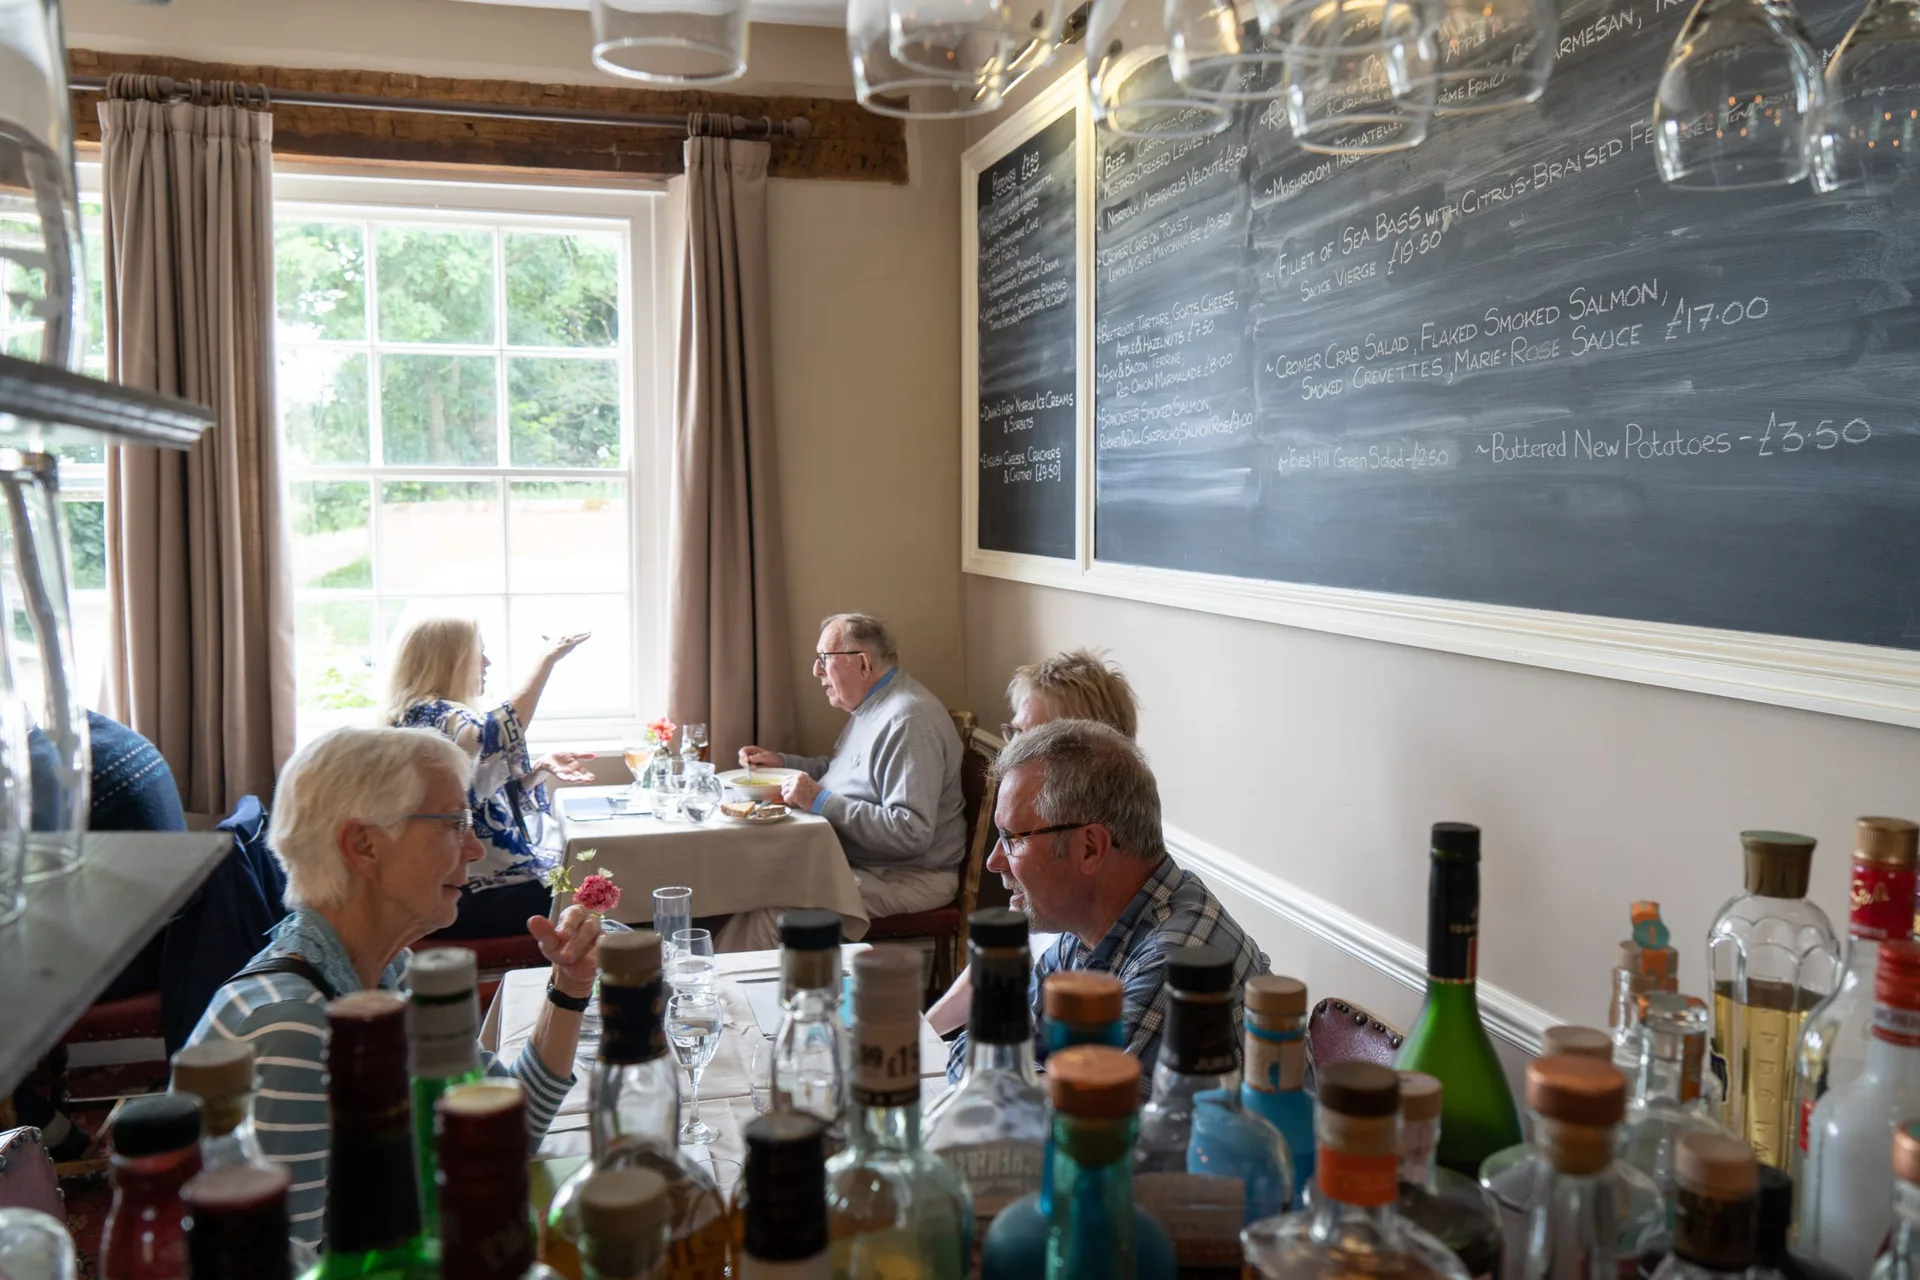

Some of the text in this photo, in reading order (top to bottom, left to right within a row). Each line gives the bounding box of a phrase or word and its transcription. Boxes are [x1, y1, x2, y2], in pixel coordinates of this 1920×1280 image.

[1552, 8, 1642, 60] ARMESAN,
[1105, 151, 1126, 180] BEEF
[1273, 161, 1331, 198] MUSHROOM
[1107, 202, 1140, 229] NORFOLK
[1143, 175, 1186, 211] ASPARAGUS
[1101, 242, 1128, 266] CROMER
[1129, 235, 1149, 254] CRAB
[1279, 251, 1315, 278] FILLET
[1320, 241, 1334, 262] OF
[1342, 226, 1370, 254] SEA
[1375, 206, 1421, 242] BASS
[1300, 230, 1442, 301] SAUCE VIERGE £19.50
[1101, 323, 1135, 344] BEETROOT
[1172, 302, 1199, 321] GOATS
[1275, 354, 1321, 379] CROMER
[1325, 343, 1360, 369] CRAB
[1421, 321, 1478, 351] FLAKED
[1484, 306, 1560, 337] SMOKED
[1569, 278, 1667, 321] SALMON,
[1301, 376, 1343, 400] SMOKED
[1571, 324, 1642, 357] SAUCE
[1665, 296, 1769, 341] £17.00
[1116, 381, 1130, 401] RED
[1155, 366, 1201, 388] MARMALADE
[1124, 359, 1148, 378] BACON
[1045, 390, 1074, 409] CREAMS
[1141, 401, 1172, 422] SMOKED
[1027, 446, 1061, 462] CRACKERS
[1491, 431, 1567, 463] Buttered
[1574, 429, 1618, 459] New
[1624, 423, 1731, 459] Potatoes
[1758, 411, 1872, 457] £3.50
[1333, 447, 1367, 468] Green
[1369, 445, 1404, 468] Salad
